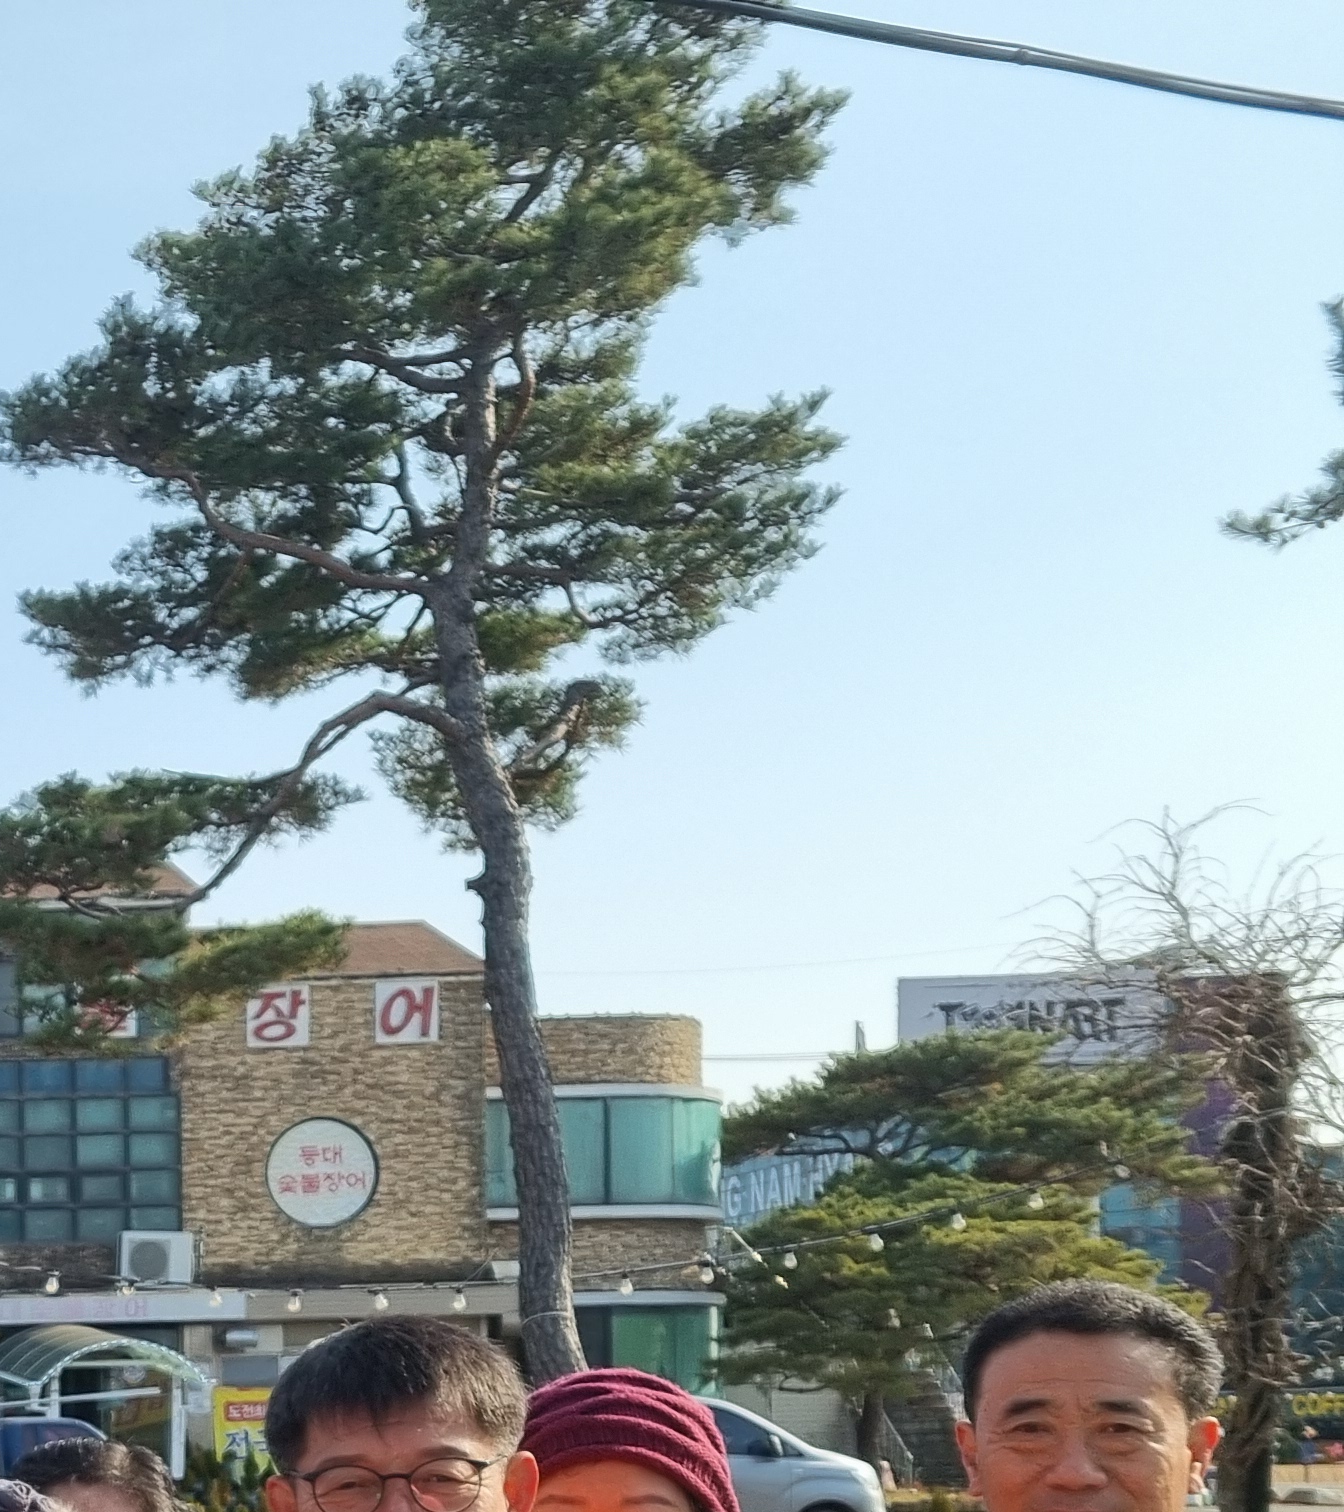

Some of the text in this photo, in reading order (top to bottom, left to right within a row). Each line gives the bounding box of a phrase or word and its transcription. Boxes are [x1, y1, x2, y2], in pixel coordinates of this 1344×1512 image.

[298, 1145, 343, 1165] 등대
[279, 1171, 367, 1196] 숯불장어
[750, 1161, 802, 1213] NAM
